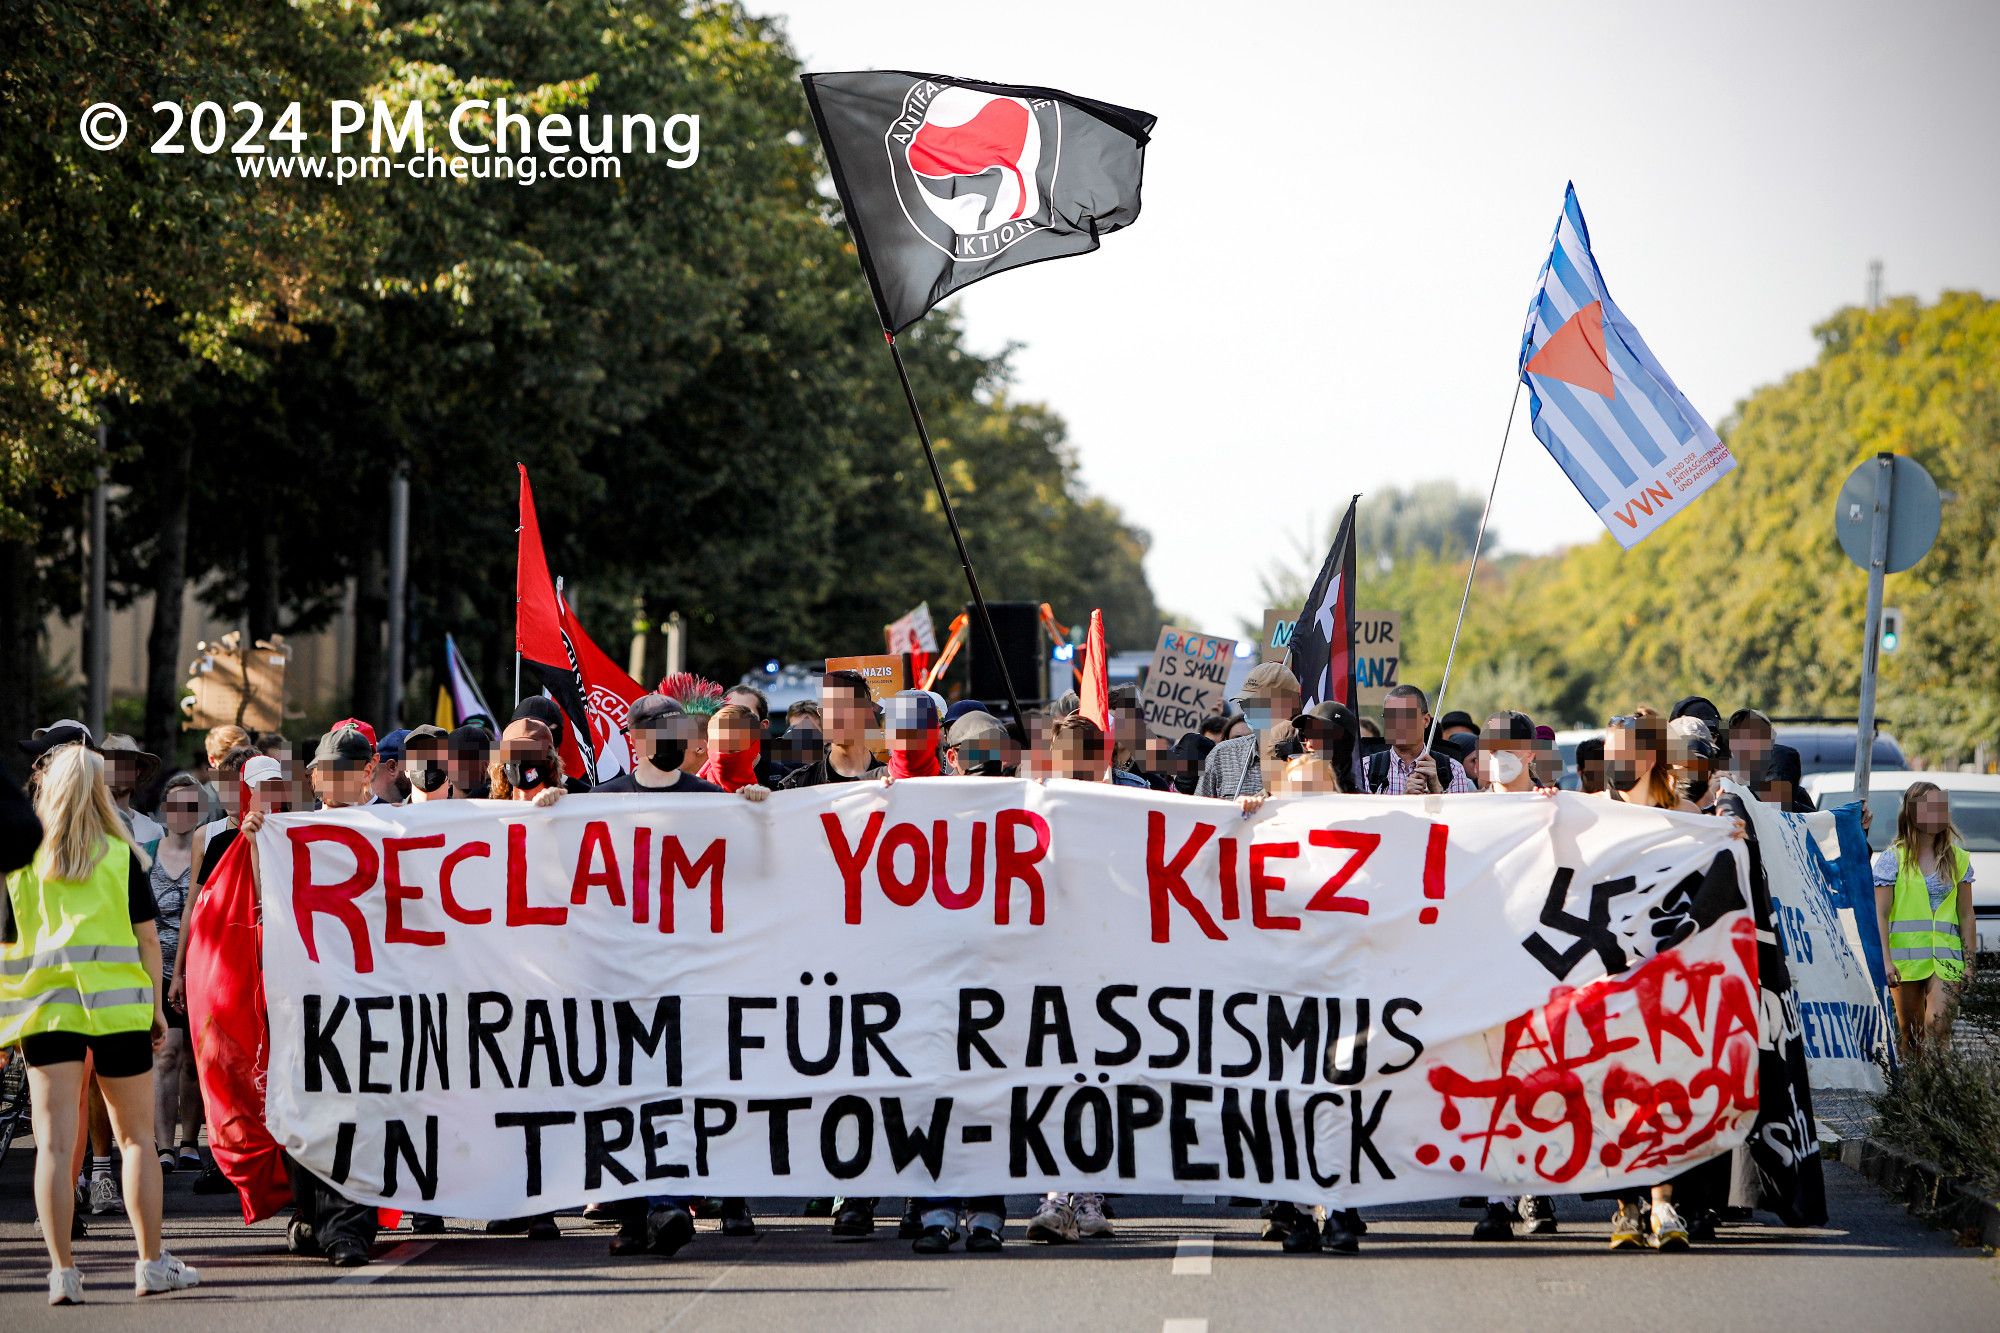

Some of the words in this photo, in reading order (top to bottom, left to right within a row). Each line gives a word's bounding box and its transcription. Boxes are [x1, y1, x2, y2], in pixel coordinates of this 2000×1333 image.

[1666, 462, 1685, 478] BUND
[1684, 452, 1697, 464] DER
[1677, 478, 1693, 491] UND
[1613, 480, 1674, 529] VVN
[1164, 632, 1230, 661] RACISM
[1159, 656, 1177, 675] IS
[1184, 660, 1226, 685] SMALL
[1356, 657, 1398, 688] ANZ
[1157, 681, 1209, 709] DICK
[286, 821, 727, 973] RECLAIM
[820, 808, 1051, 925] YOUR
[468, 990, 682, 1089] RAUM
[728, 971, 912, 1081] FÜR
[956, 984, 1423, 1086] RASSISMUS
[330, 1115, 438, 1200] IN
[495, 1072, 1397, 1197] TREPTOW-KÖPENICK
